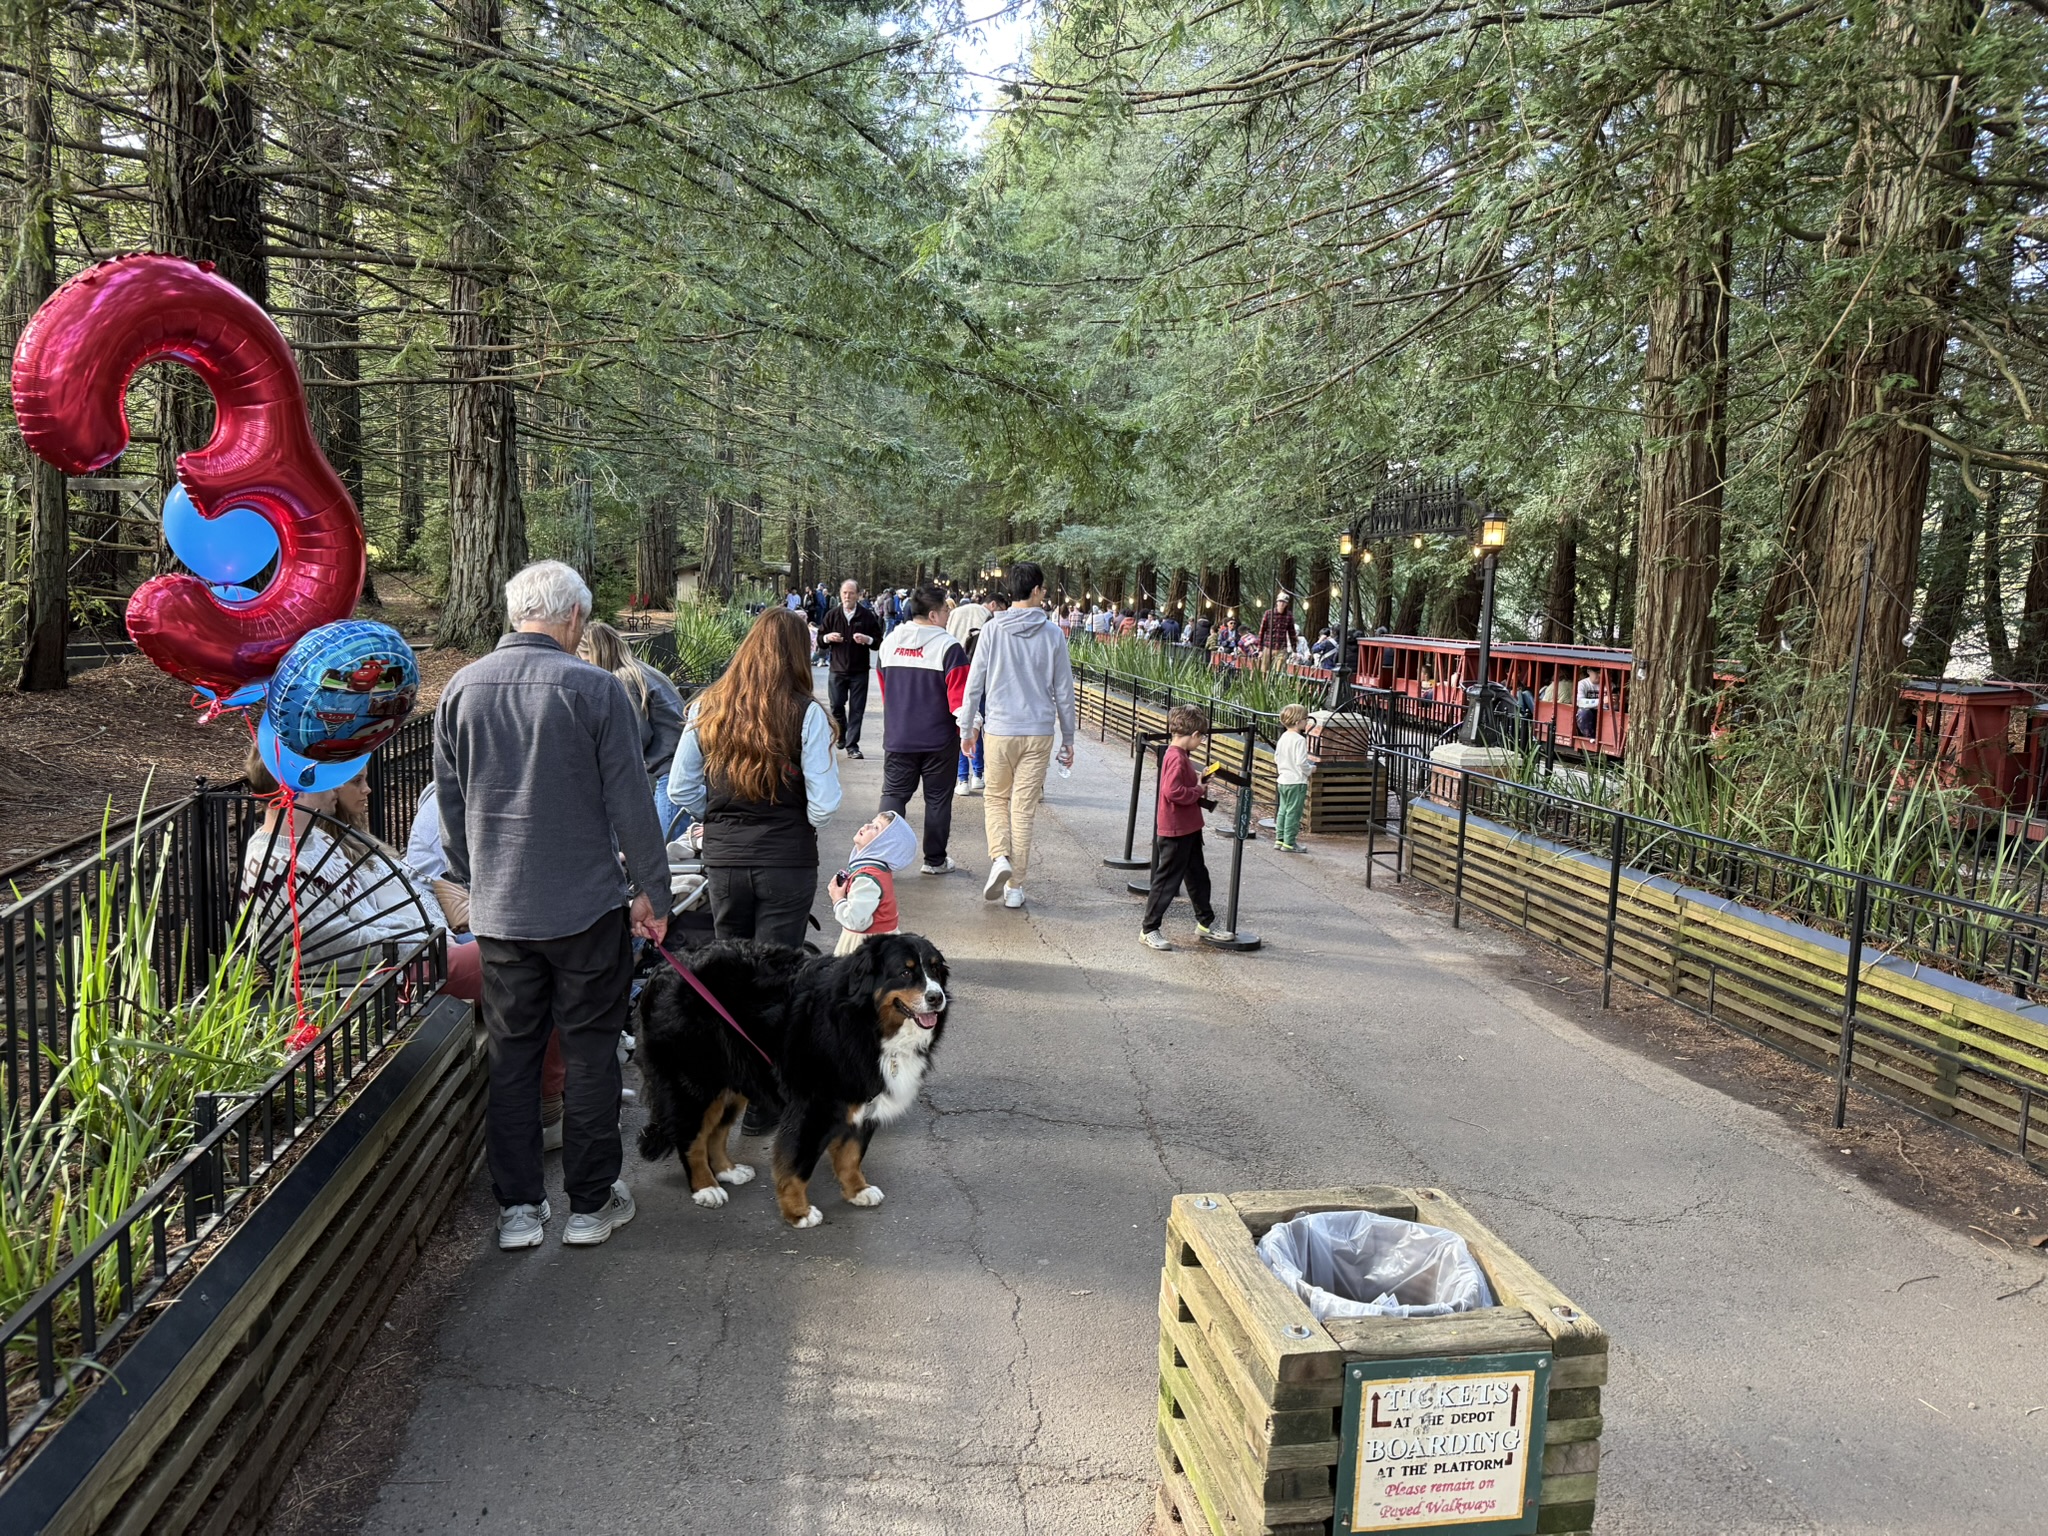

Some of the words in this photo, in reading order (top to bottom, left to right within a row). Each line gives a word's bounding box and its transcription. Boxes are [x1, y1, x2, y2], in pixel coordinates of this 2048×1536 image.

[12, 251, 366, 698] 3
[894, 646, 924, 658] FRANK
[1384, 1382, 1509, 1412] TICKETS
[1394, 1416, 1412, 1429] AT
[1419, 1414, 1445, 1427] THE
[1451, 1411, 1495, 1424] DEPOT
[1366, 1429, 1520, 1463] BOARDING
[1378, 1467, 1395, 1479] AT
[1401, 1464, 1427, 1476] THE
[1434, 1459, 1504, 1474] PLATFORM
[1385, 1482, 1427, 1497] Please
[1430, 1480, 1475, 1493] remain
[1480, 1479, 1495, 1489] on
[1380, 1501, 1424, 1518] Paved
[1426, 1498, 1497, 1514] Walkways
